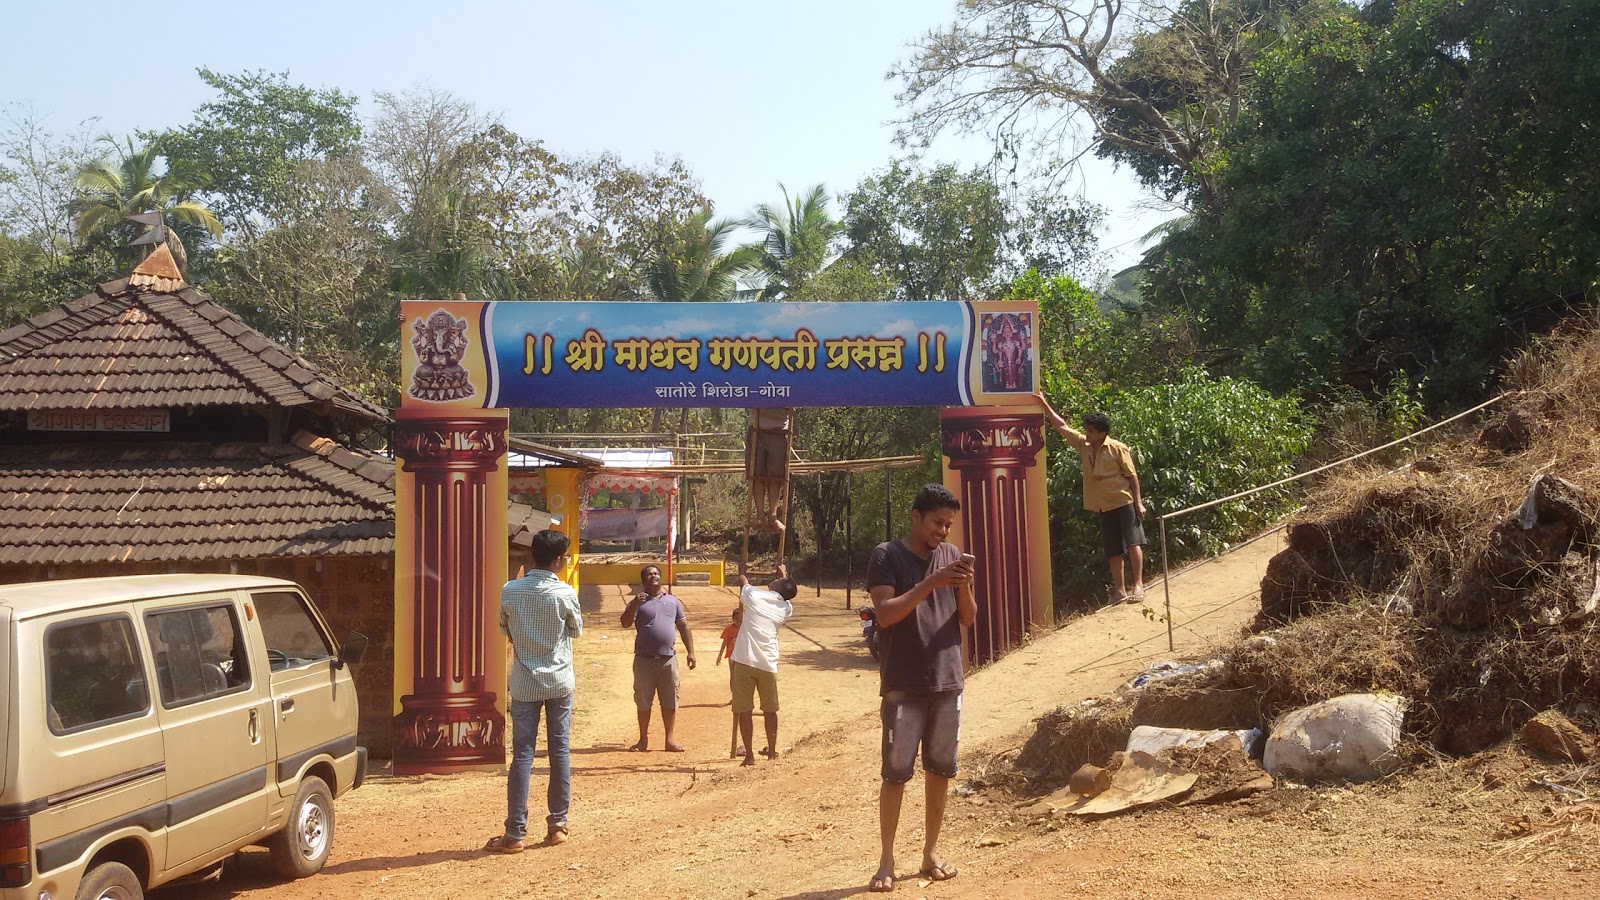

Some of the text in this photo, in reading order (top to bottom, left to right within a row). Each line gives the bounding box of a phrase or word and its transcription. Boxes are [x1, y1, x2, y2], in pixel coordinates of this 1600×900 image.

[564, 328, 606, 372] श्री
[613, 337, 701, 372] माधव
[708, 327, 818, 373] गणपती
[824, 336, 905, 373] प्रसन्न
[654, 381, 698, 398] सातोरे
